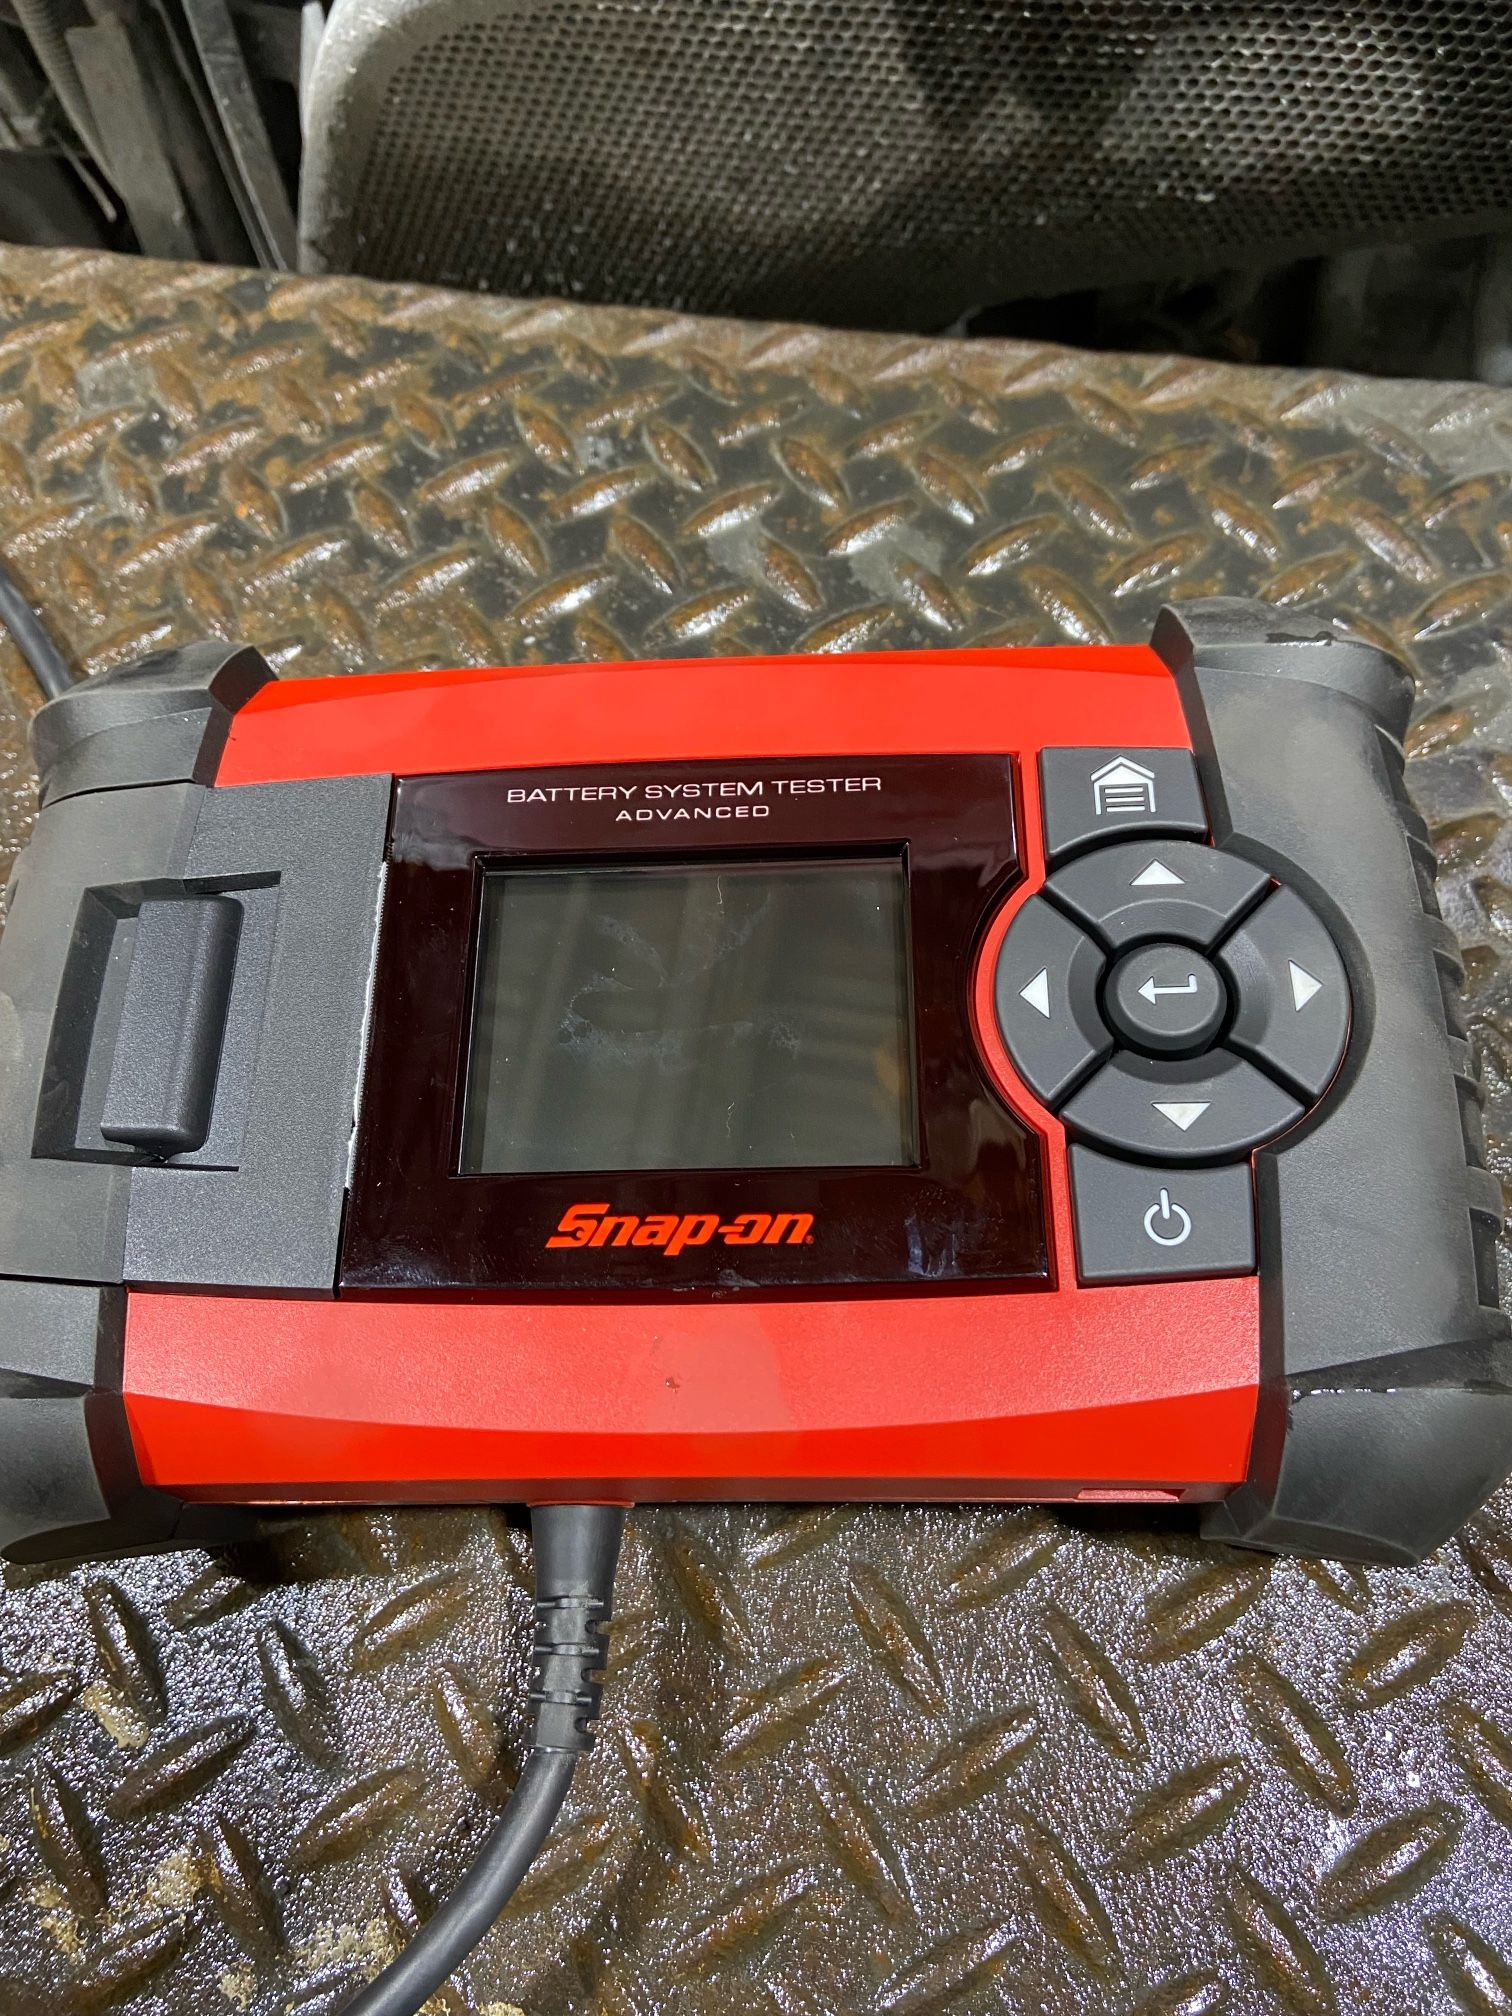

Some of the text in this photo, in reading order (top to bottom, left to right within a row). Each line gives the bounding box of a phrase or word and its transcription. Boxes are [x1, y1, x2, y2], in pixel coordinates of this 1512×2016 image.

[506, 776, 882, 803] BATTERY SYSTEM TESTER
[615, 805, 770, 821] ADVANCED
[544, 1203, 814, 1256] Snap-on
